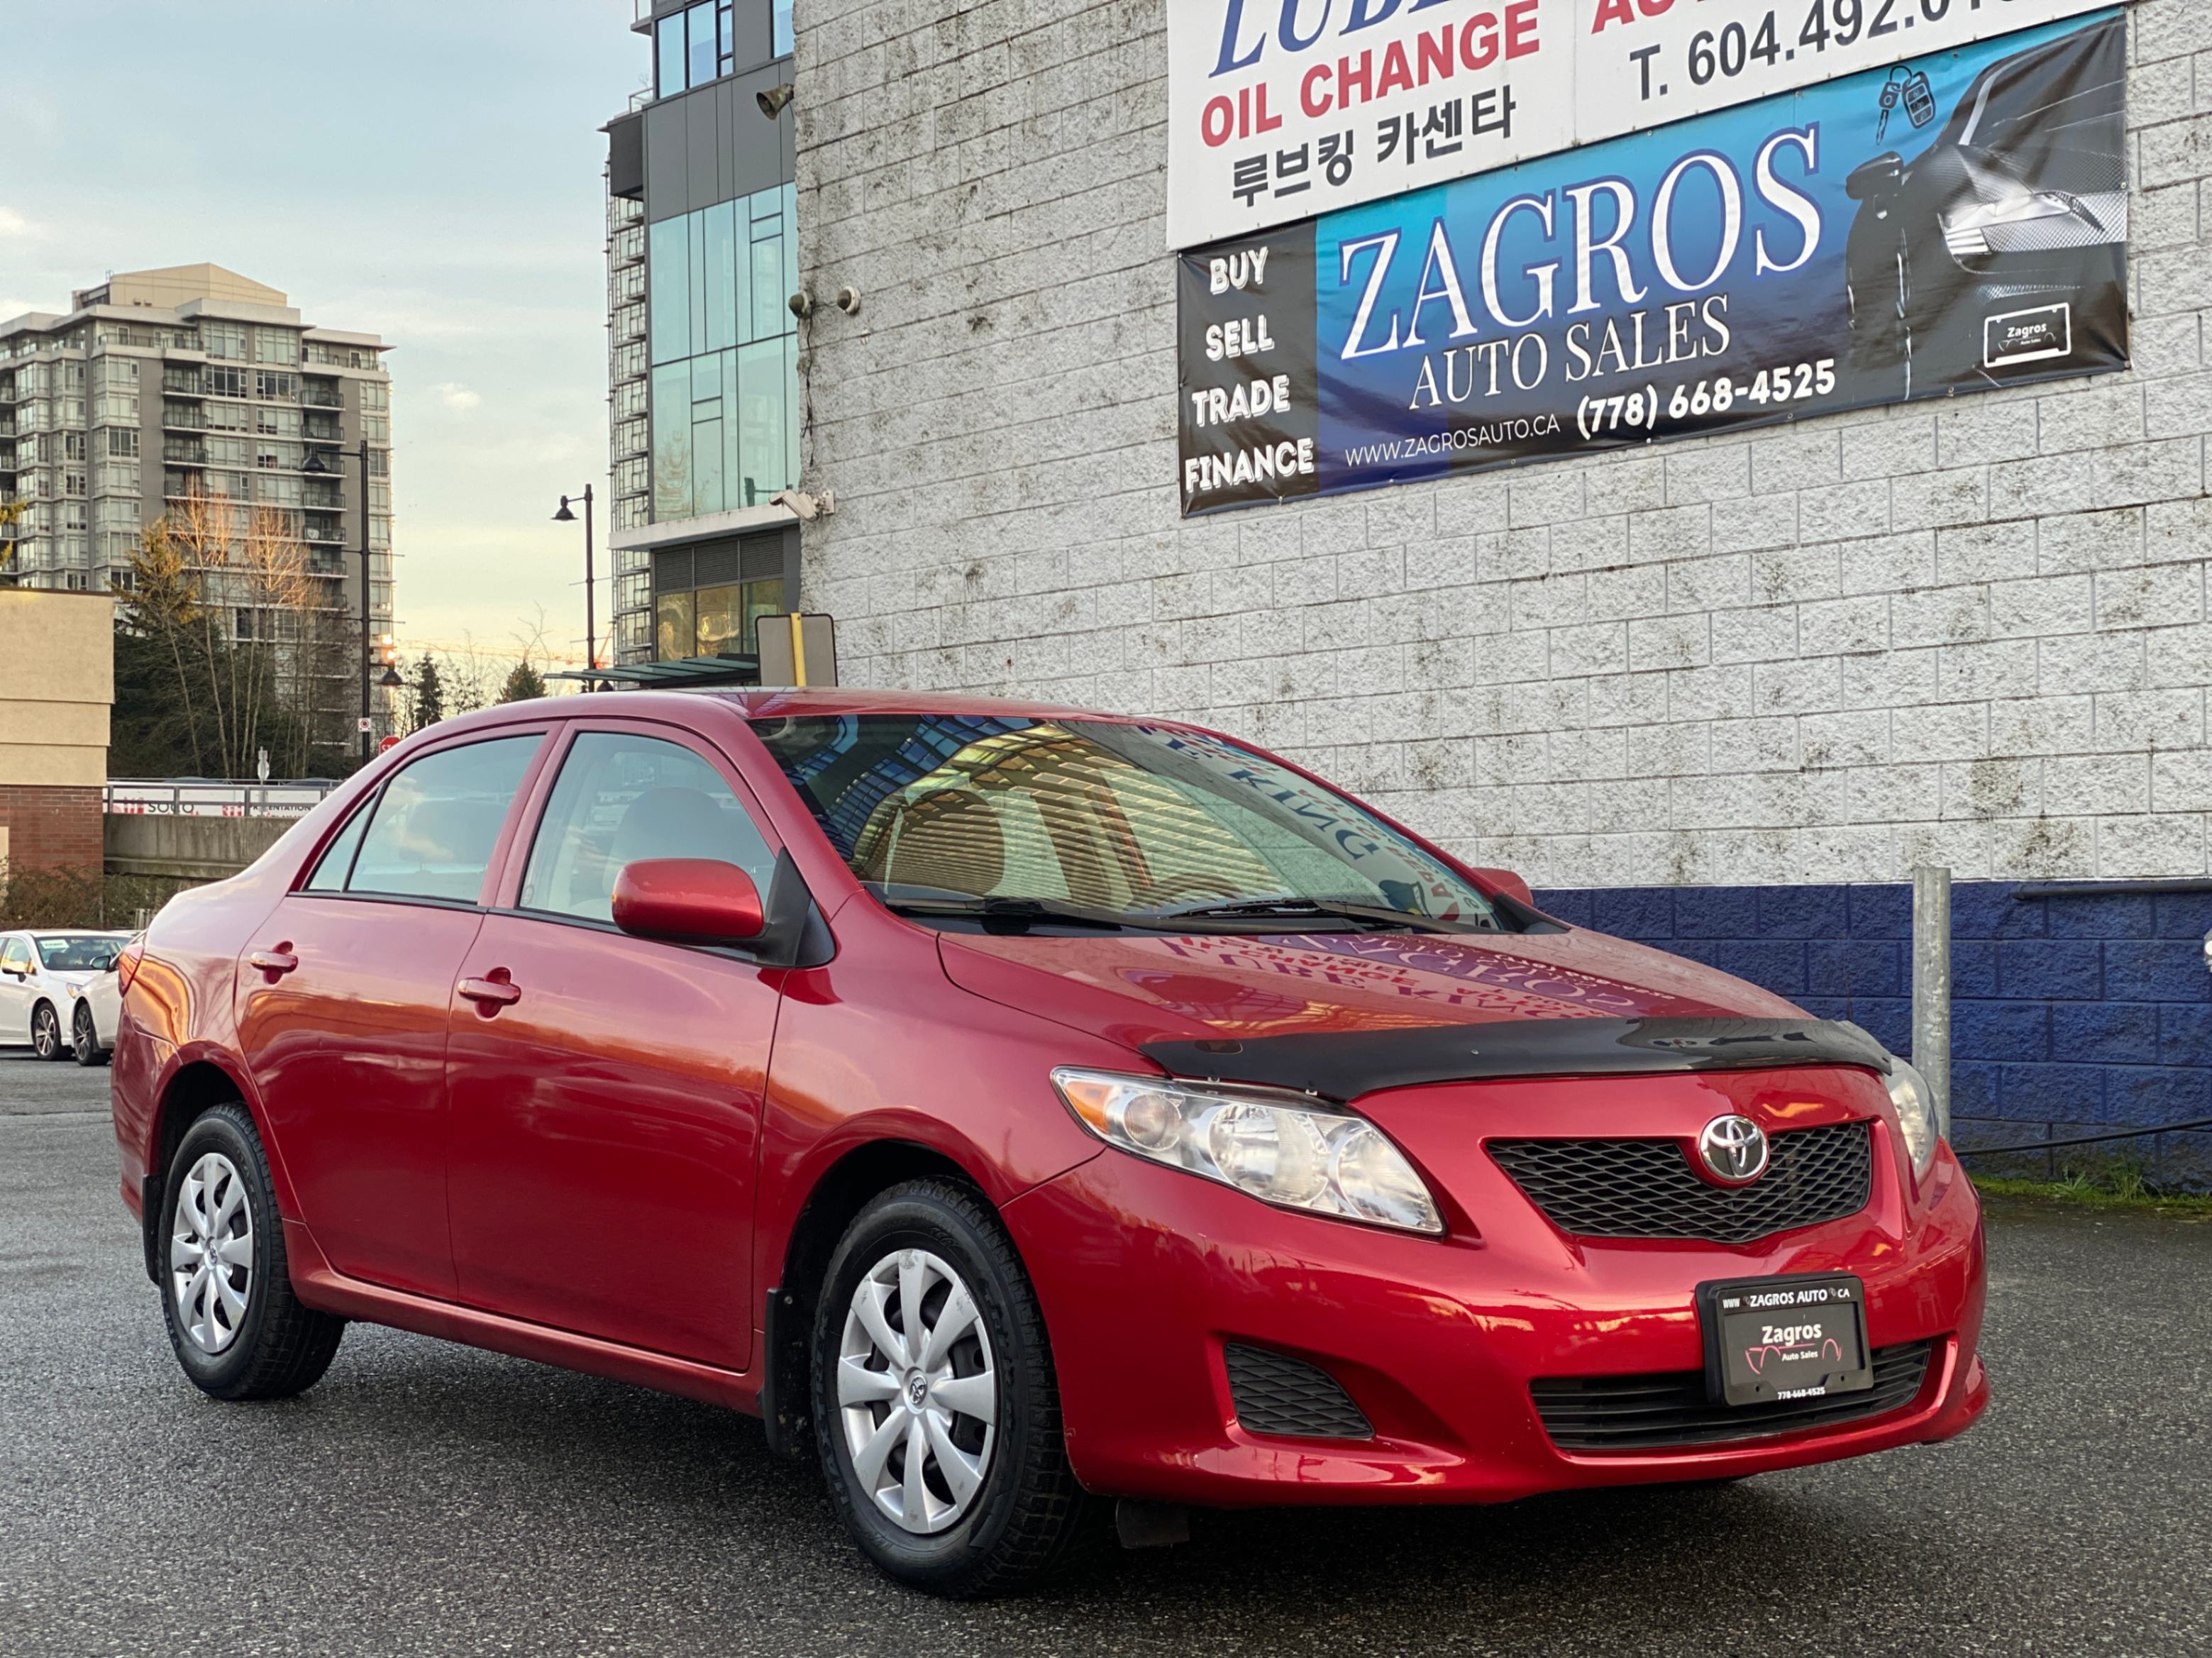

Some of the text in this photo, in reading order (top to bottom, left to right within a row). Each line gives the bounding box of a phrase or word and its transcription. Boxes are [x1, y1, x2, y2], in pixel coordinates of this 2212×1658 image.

[1208, 0, 1451, 78] LU
[1201, 0, 1540, 148] OIL CHANGE
[1630, 44, 1668, 101] T.
[1232, 84, 1517, 207] 루브킹 카센타
[1210, 246, 1268, 294] BUY
[1340, 126, 1823, 360] ZAGROS
[1205, 314, 1275, 361] SELL
[1409, 294, 1730, 410] AUTO SALES
[2007, 323, 2047, 338] Zagros
[1192, 375, 1291, 427] TRADE
[1577, 358, 1836, 441] (778) 668-4525
[1185, 437, 1315, 493] FINANCE
[1345, 413, 1561, 467] WWW.ZAGROSAUTO.CA
[1722, 1288, 1850, 1309] WWW ZAGROS AUTO CA
[1762, 1323, 1822, 1347] Zagros
[1781, 1351, 1818, 1361] Auto Sales
[1777, 1386, 1826, 1400] 778-668-4525
